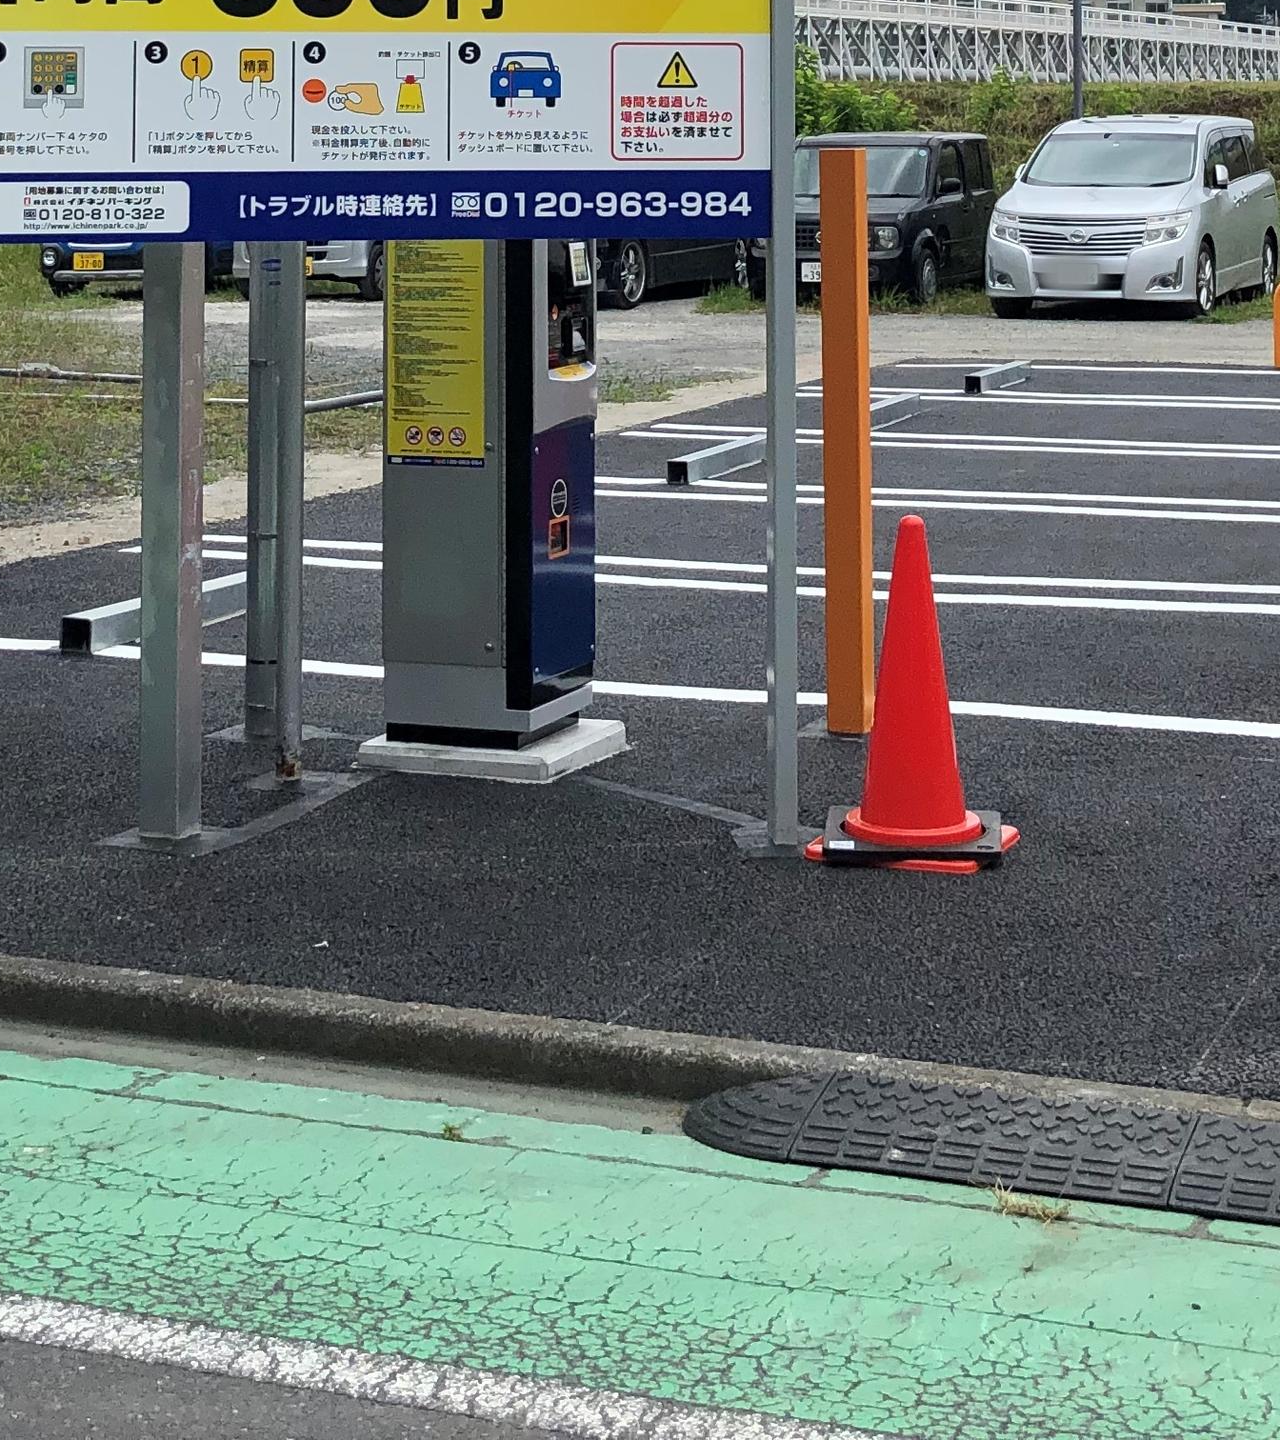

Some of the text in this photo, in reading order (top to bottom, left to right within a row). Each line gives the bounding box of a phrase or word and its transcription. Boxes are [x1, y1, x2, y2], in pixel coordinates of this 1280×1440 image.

[192, 57, 199, 74] 1
[621, 96, 708, 108] 時間を超過した
[507, 109, 542, 119] チケット
[620, 111, 732, 123] 場合は必ず超過分の
[311, 125, 411, 135] 現金を投入して下さい。
[458, 130, 588, 141] チケットを外から見えるように
[621, 126, 733, 138] お支払いを済ませて
[458, 144, 593, 154] ダッシュボードに置いて下さい。
[621, 141, 664, 153] 下さい。
[321, 152, 431, 161] チケットが発行されます。
[485, 192, 752, 217] 0120-963-984
[39, 208, 165, 220] 0120-810-322
[23, 222, 148, 231] http://www.ichinenpark.co.jp/
